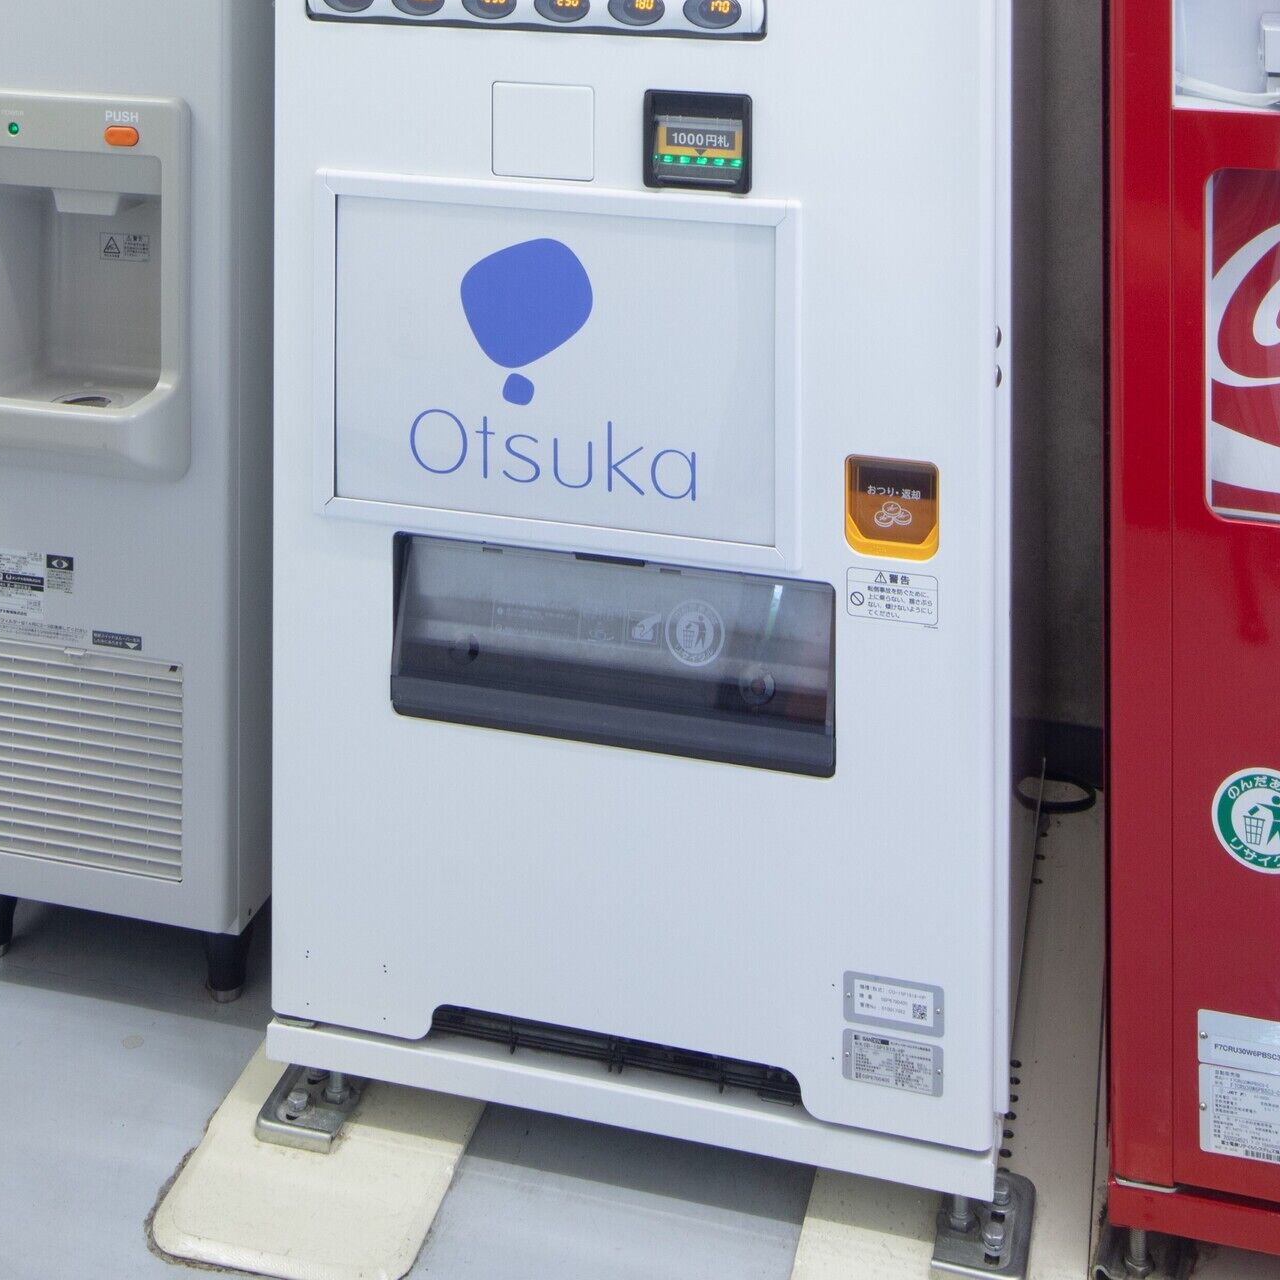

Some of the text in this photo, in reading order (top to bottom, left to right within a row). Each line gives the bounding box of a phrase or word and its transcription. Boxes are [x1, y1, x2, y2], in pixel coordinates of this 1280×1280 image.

[105, 110, 139, 124] PUSH
[671, 130, 730, 148] 1000円札
[409, 407, 698, 503] Otsuka
[867, 484, 921, 501] おつり・返却
[888, 573, 911, 586] 警告
